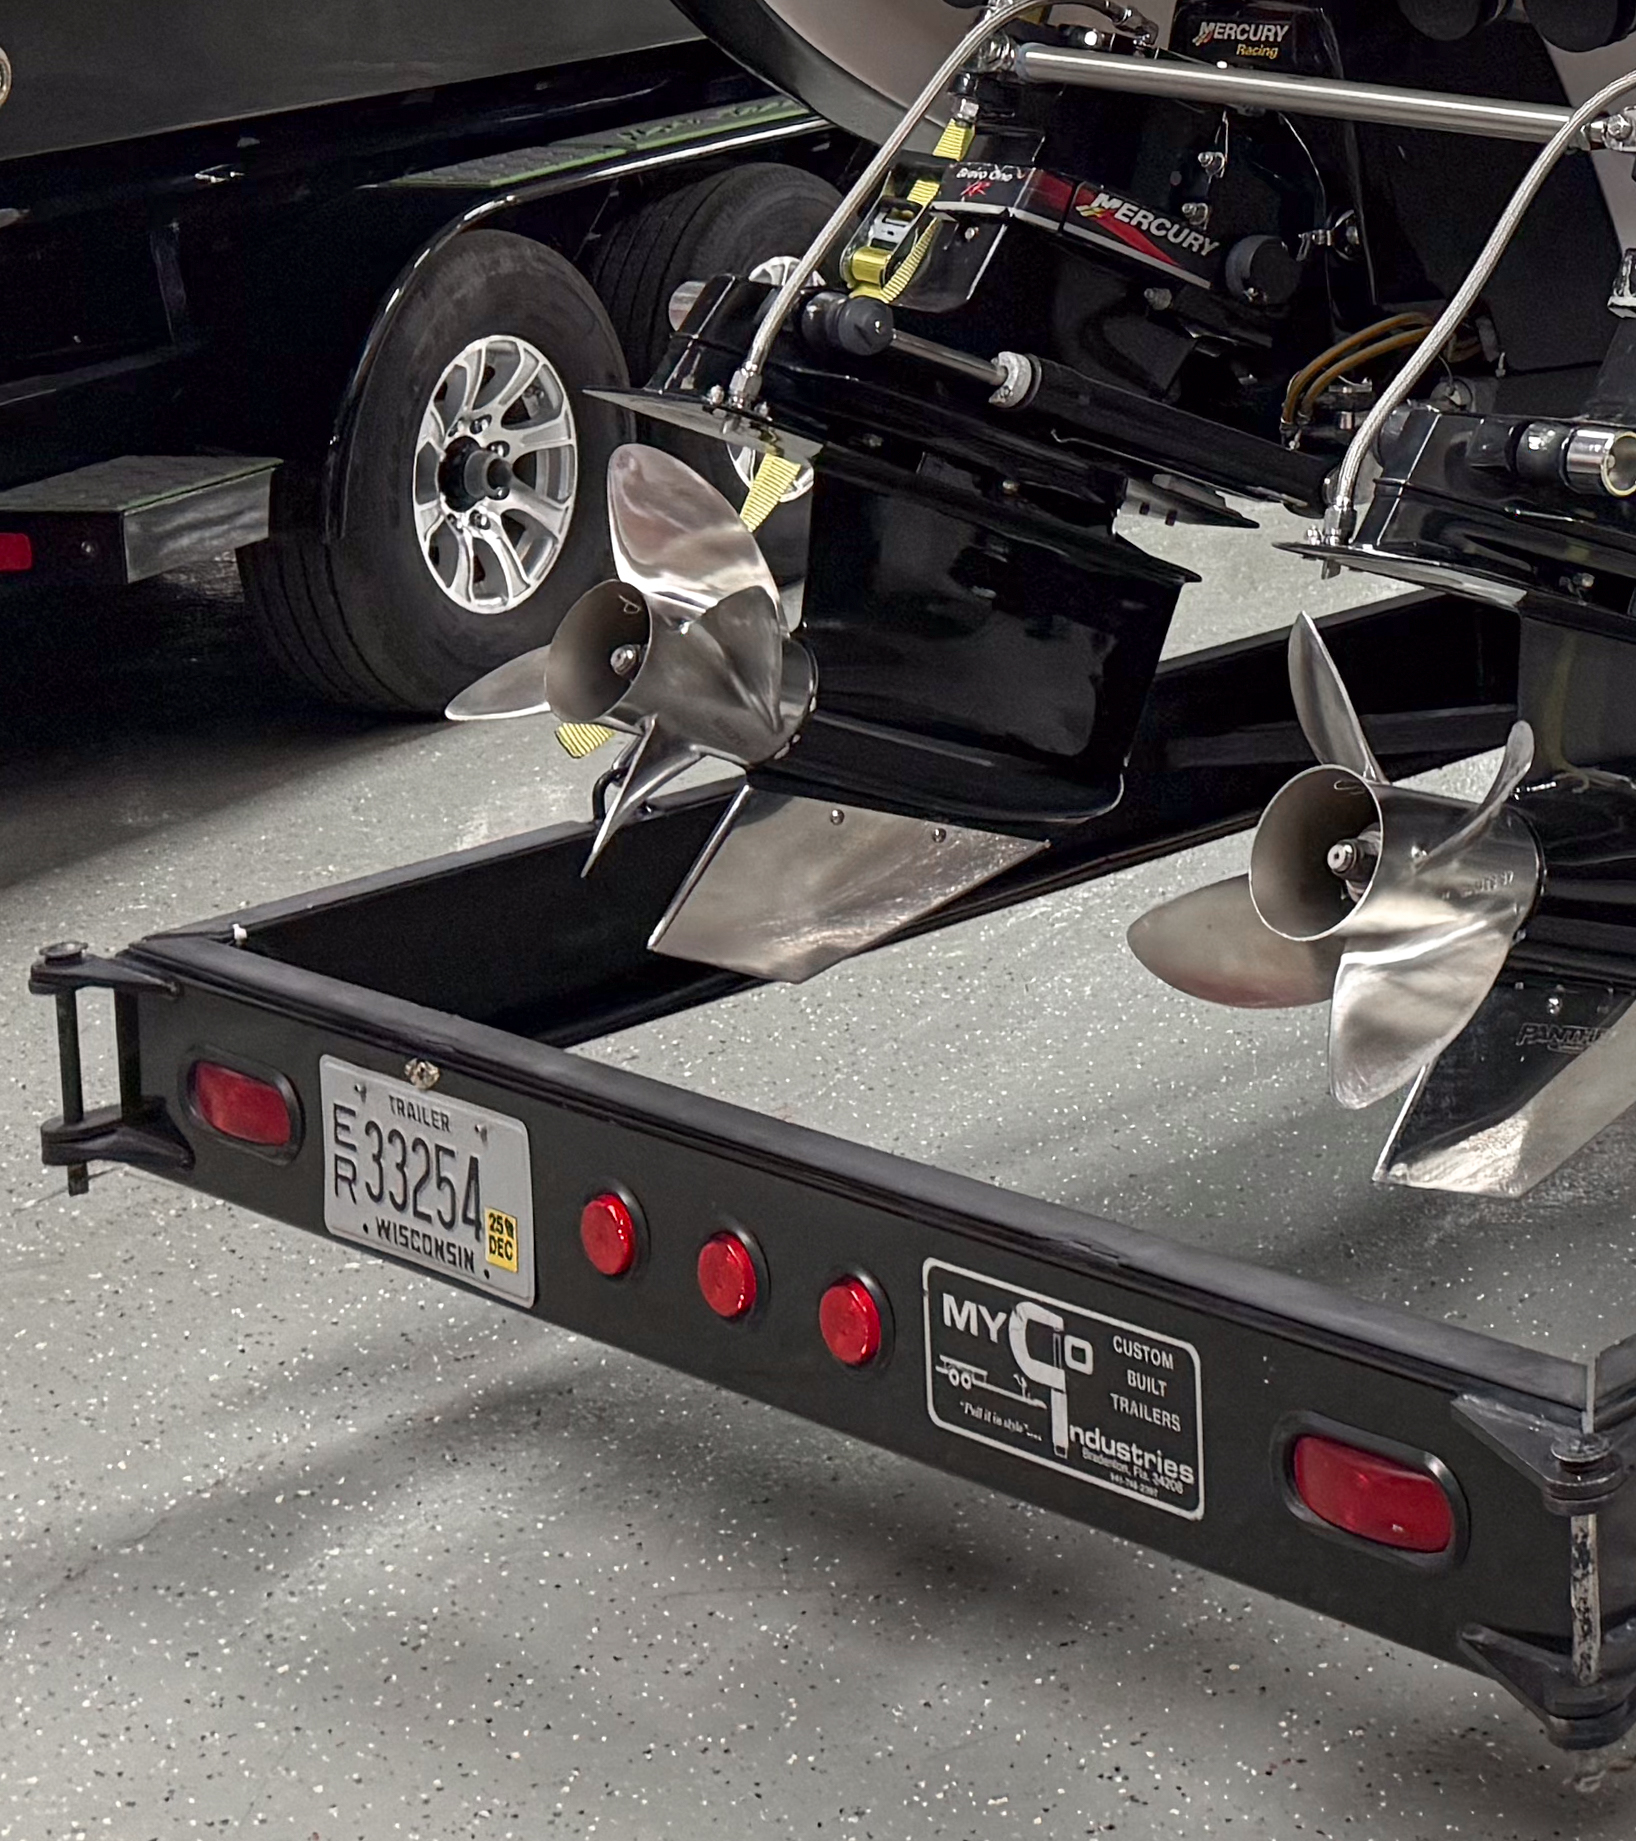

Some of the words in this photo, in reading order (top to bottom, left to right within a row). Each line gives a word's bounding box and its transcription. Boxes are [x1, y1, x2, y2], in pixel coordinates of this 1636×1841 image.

[1195, 21, 1290, 44] MERCURY
[1236, 43, 1279, 59] Racing
[1088, 192, 1220, 257] MERCURY
[389, 1095, 450, 1132] TRAILER
[365, 1120, 482, 1242] 33254
[489, 1212, 503, 1236] 25
[376, 1216, 475, 1274] WISCONSIN
[489, 1235, 513, 1261] DEC
[1112, 1335, 1174, 1370] CUSTOM
[1127, 1369, 1168, 1397] BUILT
[1110, 1393, 1181, 1432] TRAILERS
